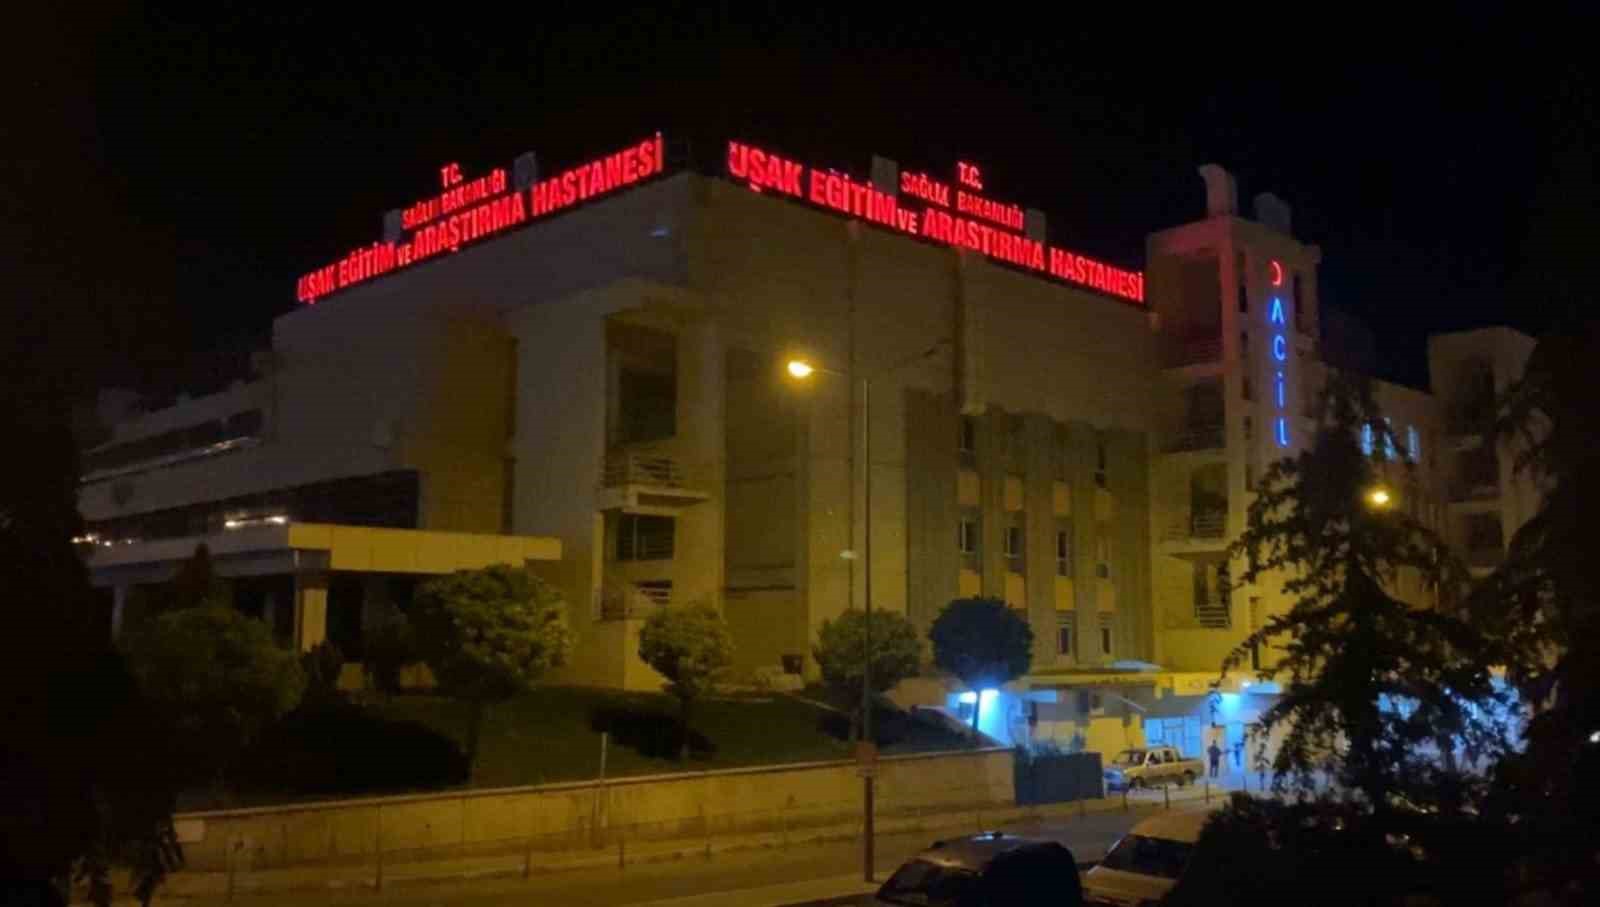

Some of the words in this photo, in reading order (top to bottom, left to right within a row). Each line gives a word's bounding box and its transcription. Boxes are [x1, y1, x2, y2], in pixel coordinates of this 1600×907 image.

[339, 240, 395, 288] EĞİTİM
[396, 243, 412, 267] VE
[412, 191, 526, 260] ARAŞTIRMA
[531, 131, 663, 217] HASTANESİ
[728, 140, 803, 198] UŞAK
[810, 167, 897, 227] EĞİTİM
[897, 208, 918, 234] VE
[1050, 247, 1144, 303] HASTANESİ
[1270, 297, 1288, 446] ACİL
